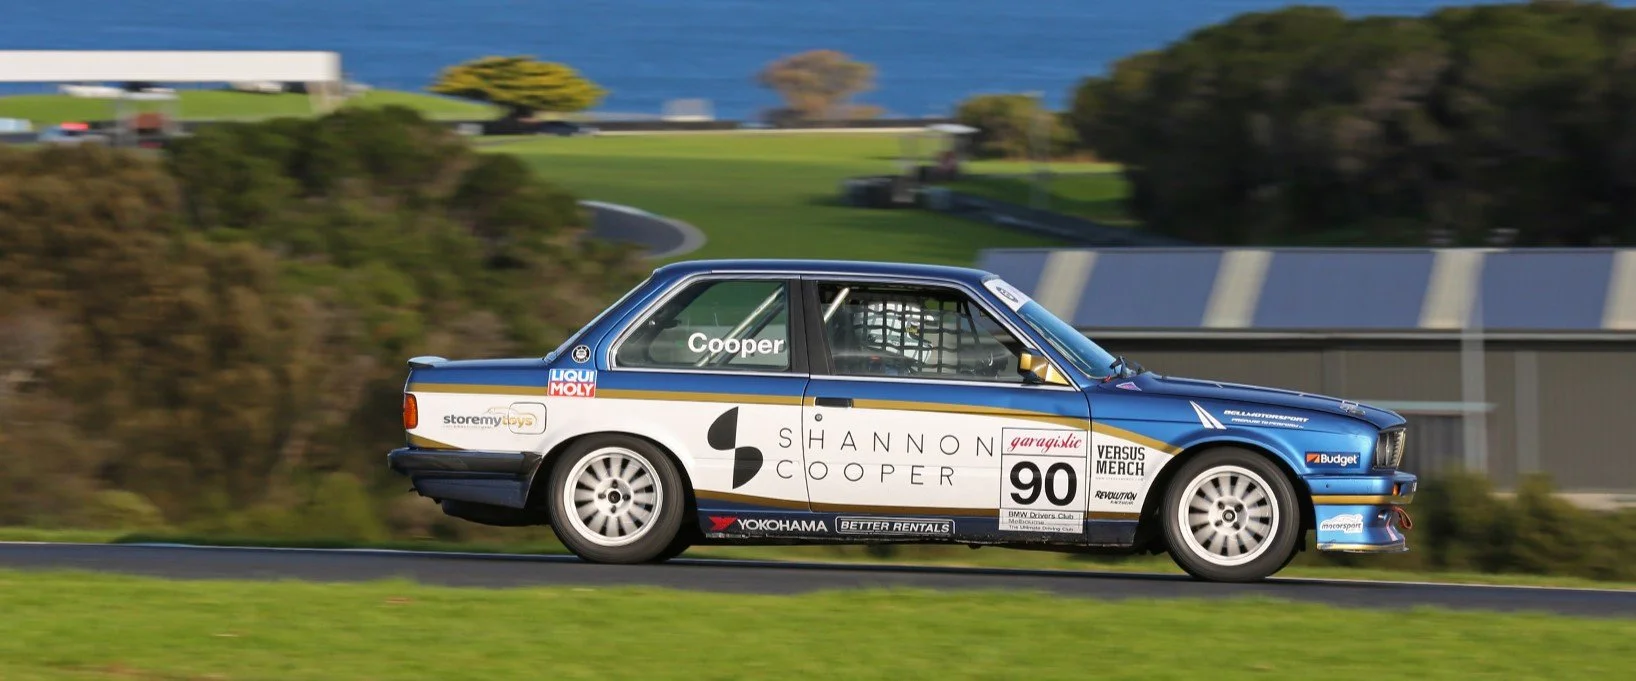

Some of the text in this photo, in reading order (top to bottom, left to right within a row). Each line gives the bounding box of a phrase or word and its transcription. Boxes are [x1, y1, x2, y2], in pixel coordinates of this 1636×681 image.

[687, 332, 785, 358] Cooper
[551, 369, 595, 383] LIQUI
[550, 382, 594, 397] MOLY
[778, 427, 994, 457] SHANNON
[1007, 433, 1082, 453] garagistic
[1097, 444, 1145, 461] VERSUS
[1320, 453, 1358, 467] Budget
[776, 459, 954, 486] COOPER
[1096, 460, 1145, 476] MERCH
[1010, 461, 1077, 506] 90
[1094, 490, 1138, 501] REVOLUTION
[1008, 510, 1074, 520] BMW Drivers Club
[737, 518, 828, 532] YOKOHAMA
[840, 520, 950, 533] BETTER RENTALS
